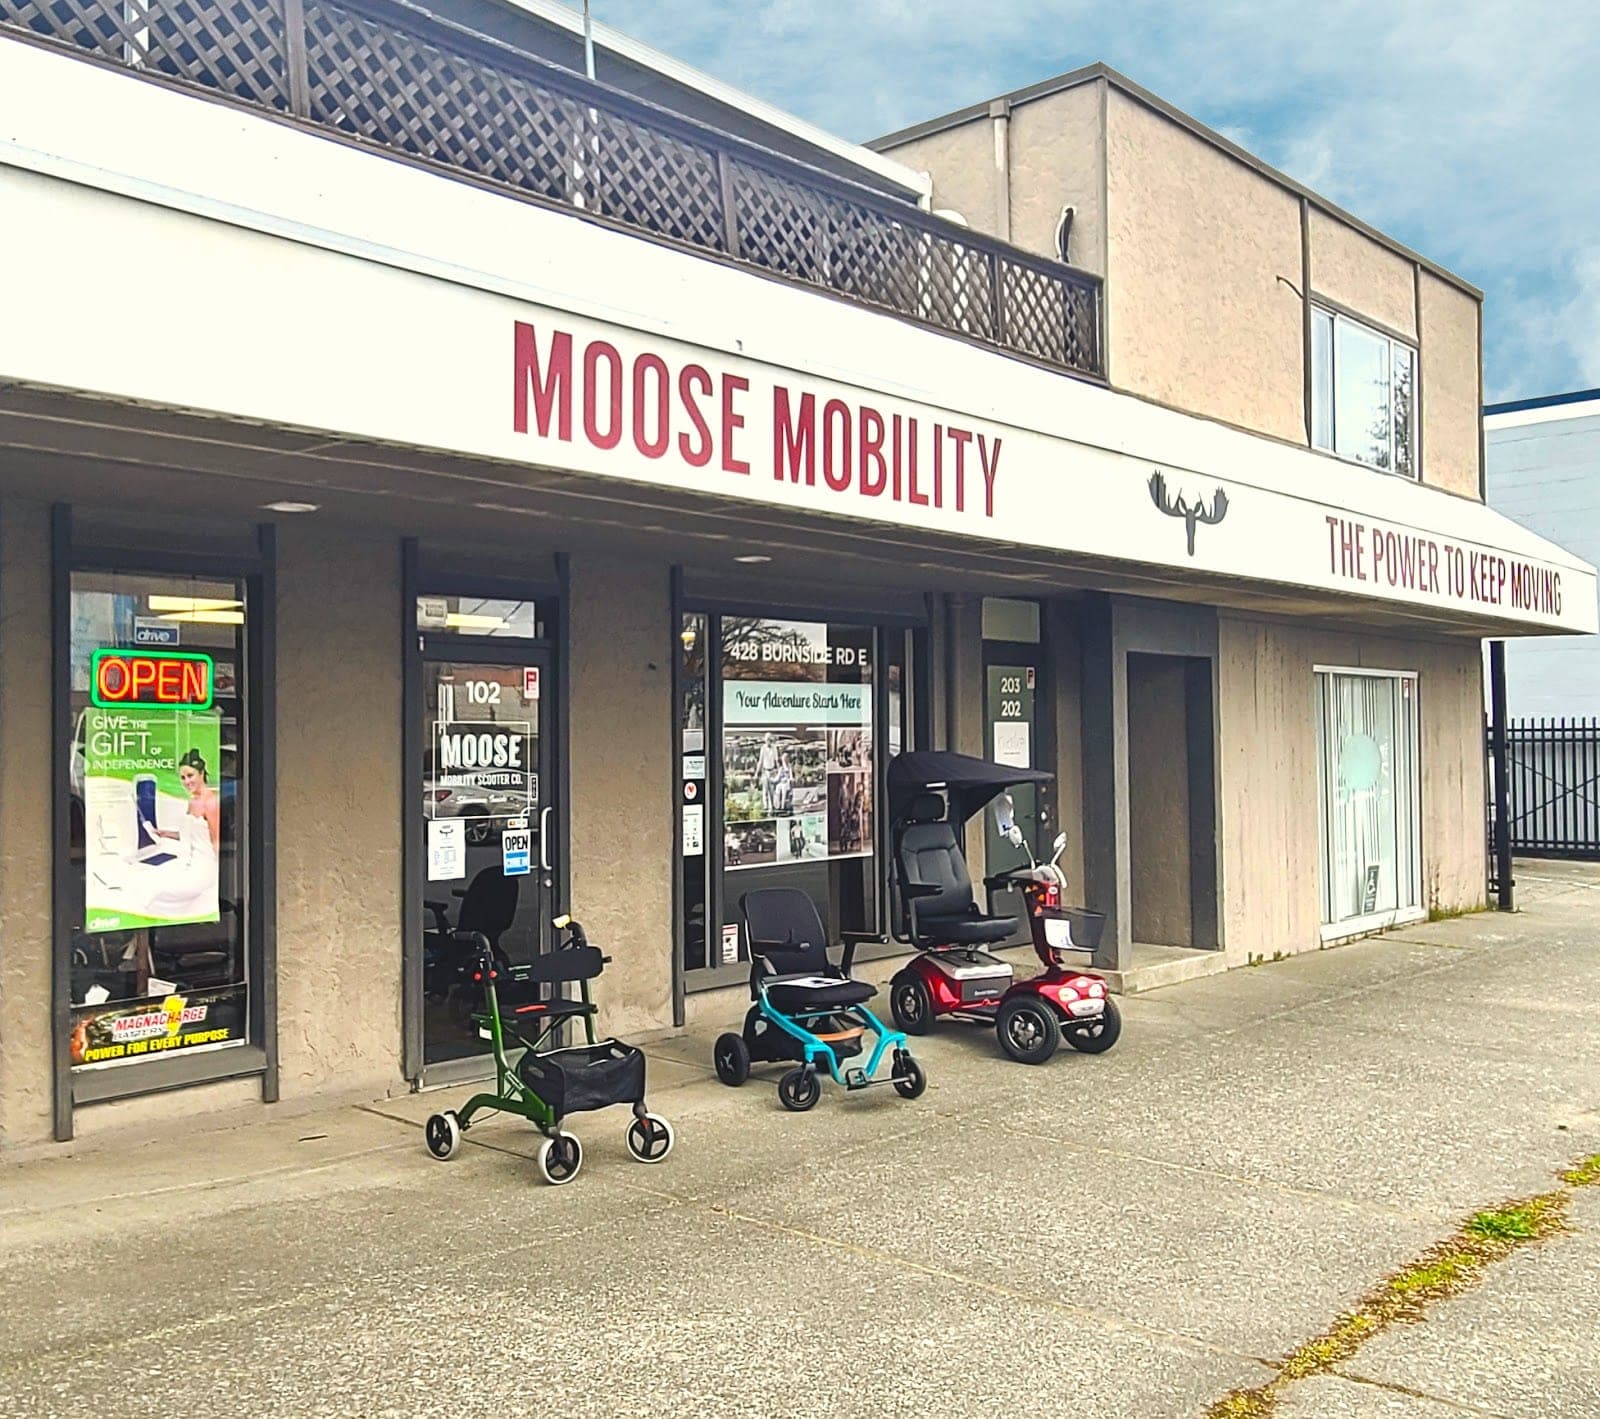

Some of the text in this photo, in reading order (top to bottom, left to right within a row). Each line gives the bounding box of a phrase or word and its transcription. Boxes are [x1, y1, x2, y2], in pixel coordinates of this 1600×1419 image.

[513, 319, 1002, 518] MOOSE MOBILITY
[1325, 515, 1562, 617] THE POWER TO KEEP MOVING
[137, 629, 170, 642] drive
[730, 642, 867, 666] 428 BURNSIDE RD E
[98, 656, 209, 702] OPEN
[1001, 677, 1021, 693] 203
[465, 681, 501, 704] 102
[735, 690, 861, 710] Your Adventure Starts Here
[1001, 701, 1021, 717] 202
[92, 715, 128, 730] GIVE
[91, 731, 162, 756] GIFT OF
[440, 733, 522, 769] MOOSE
[91, 758, 175, 770] INDEPENDENCE
[440, 774, 476, 786] MOBILITY
[477, 773, 510, 785] SCOOTER
[505, 835, 528, 851] OPEN
[115, 1006, 206, 1031] MAGNACHARGE
[84, 1028, 230, 1062] POWER FOR EVERY PURPOSE
